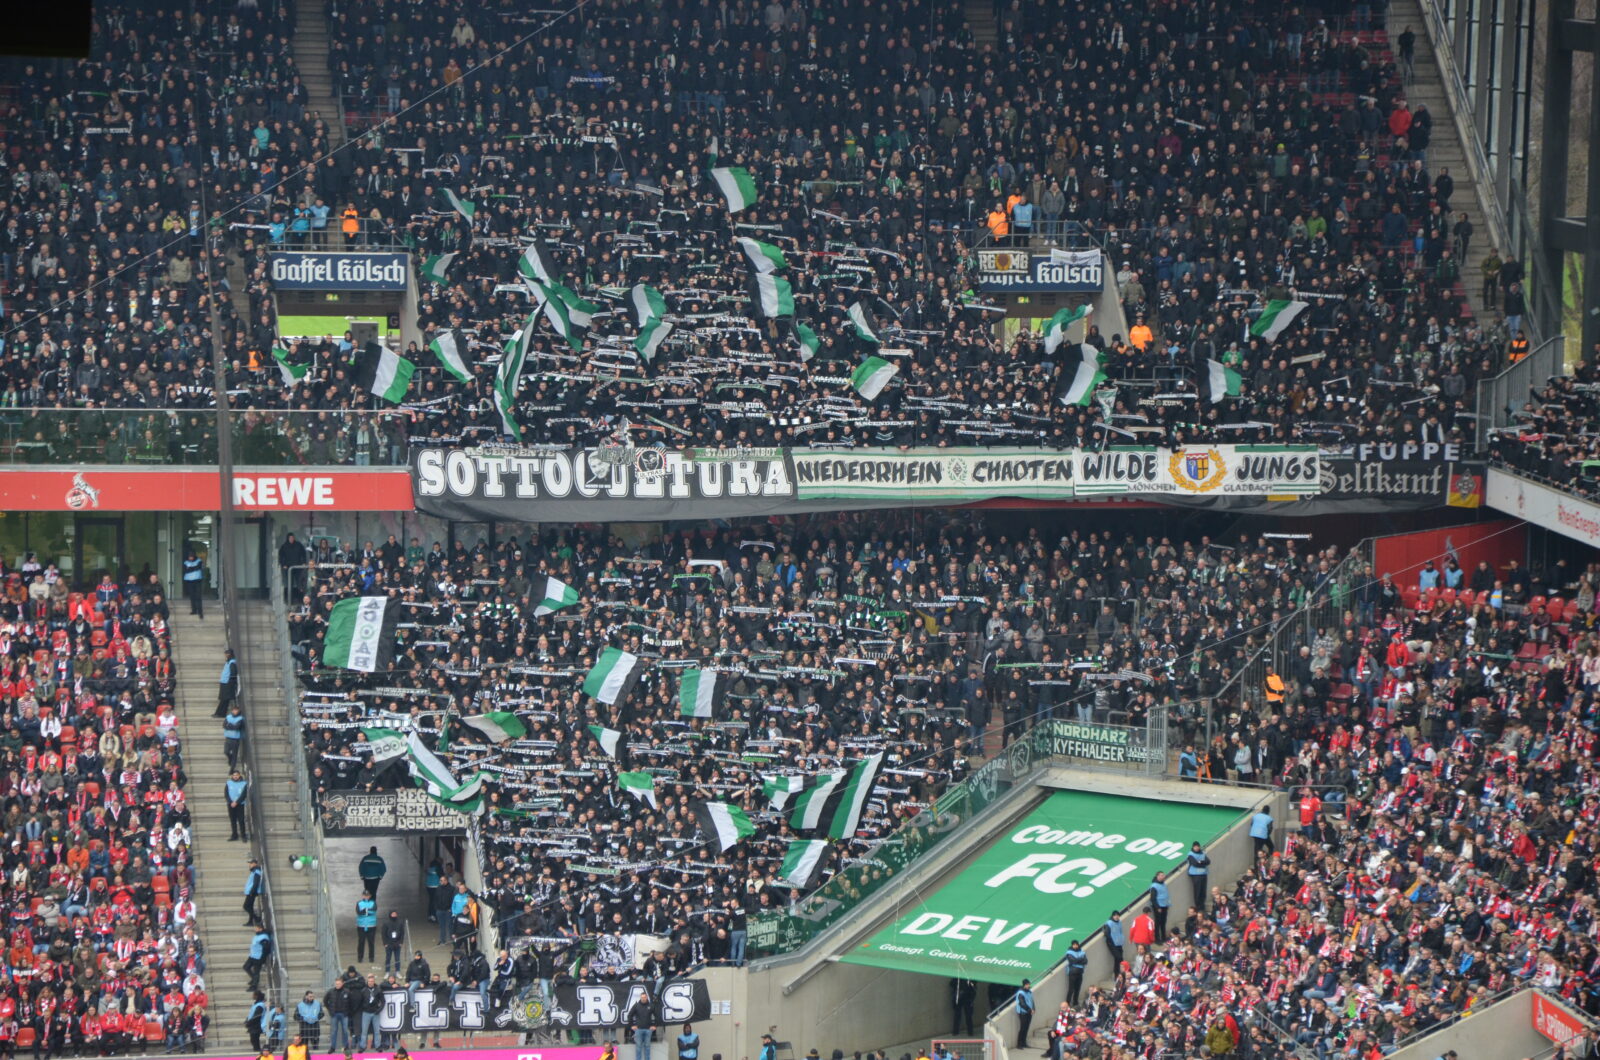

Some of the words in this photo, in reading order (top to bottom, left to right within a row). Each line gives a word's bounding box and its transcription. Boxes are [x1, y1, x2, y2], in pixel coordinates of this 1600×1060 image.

[273, 255, 334, 283] Gaffel
[337, 258, 405, 285] Kölsch
[799, 460, 942, 484] NIEDERRHEIN
[972, 460, 1072, 483] CHAOTEN
[1082, 453, 1158, 482] WILDE
[1236, 455, 1318, 482] JUNGS
[1319, 462, 1443, 497] Selfkant
[231, 478, 334, 506] REWE
[1127, 482, 1177, 492] MÖNCHEN
[1223, 484, 1273, 492] GLADBACH
[1053, 722, 1128, 744] NORDHARZ
[345, 815, 395, 827] EINIGES
[347, 805, 392, 817] GEHT
[1011, 825, 1126, 849] Come
[1125, 837, 1184, 860] on,
[984, 853, 1137, 898] FC!
[900, 912, 1073, 950] DEVK
[973, 955, 1033, 968] Geholfen.
